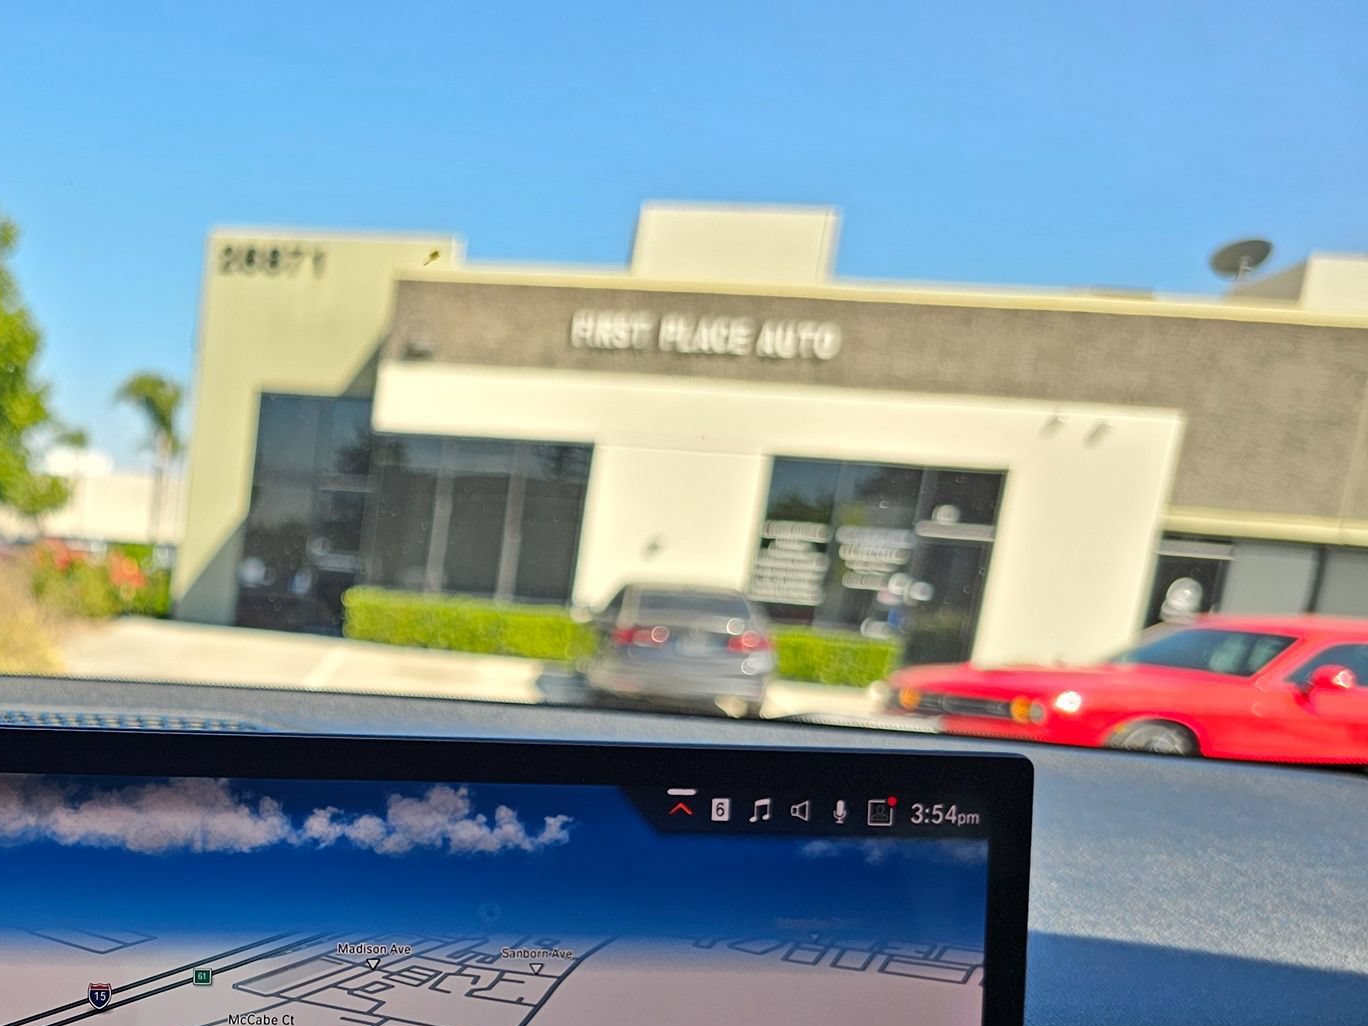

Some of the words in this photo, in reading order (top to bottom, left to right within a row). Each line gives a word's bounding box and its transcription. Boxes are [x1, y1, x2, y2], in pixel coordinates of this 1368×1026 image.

[571, 309, 652, 350] FIRST
[659, 311, 753, 357] PLACE
[755, 318, 841, 361] AUTO
[716, 803, 725, 817] 6
[910, 803, 980, 826] 3:54pm
[337, 943, 386, 955] Madison
[389, 943, 411, 955] Ave
[501, 948, 547, 959] Sanborn
[550, 948, 573, 959] Ave
[197, 972, 207, 980] 61
[94, 991, 107, 1001] 15
[228, 1014, 278, 1026] McCabe
[282, 1014, 294, 1026] Ct
